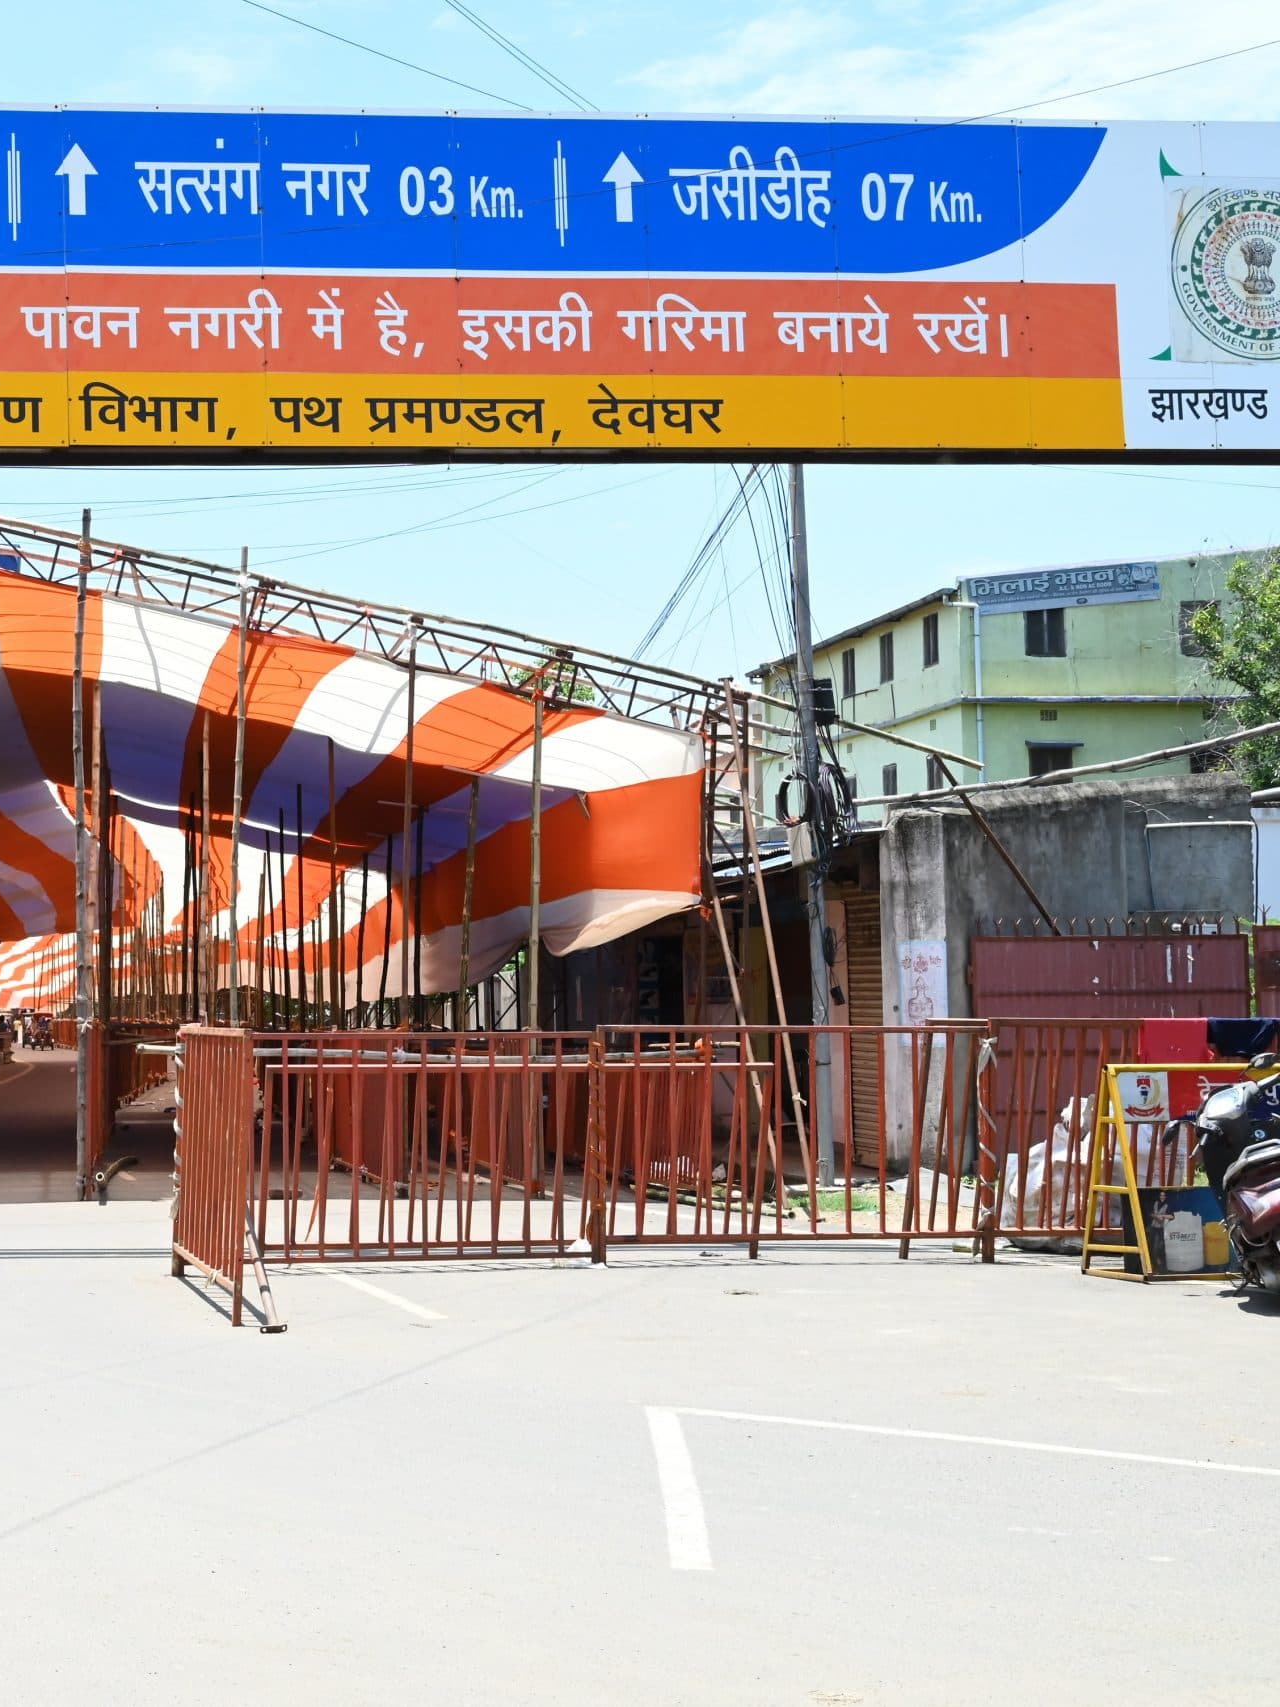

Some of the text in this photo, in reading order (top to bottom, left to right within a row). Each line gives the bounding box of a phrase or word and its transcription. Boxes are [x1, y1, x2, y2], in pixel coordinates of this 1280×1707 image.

[134, 138, 524, 219] सत्संग नगर 03 Km.
[669, 145, 983, 228] जसीडीह 07 Km.
[20, 306, 140, 349] पावन
[164, 288, 283, 350] नगरी
[306, 287, 345, 350] में
[374, 290, 426, 358] है,
[457, 291, 593, 361] इसकी
[616, 293, 747, 353] गरिमा
[773, 294, 890, 354] बनाये
[1181, 282, 1275, 352] GOVERNMENT OF
[78, 381, 238, 441] विभाग,
[269, 396, 343, 434] पथ
[365, 397, 563, 445] प्रमण्डल,
[588, 382, 724, 435] देवघर
[1148, 388, 1269, 423] झारखण्ड
[970, 573, 1051, 598] भिलाई
[1055, 567, 1116, 587] भवन
